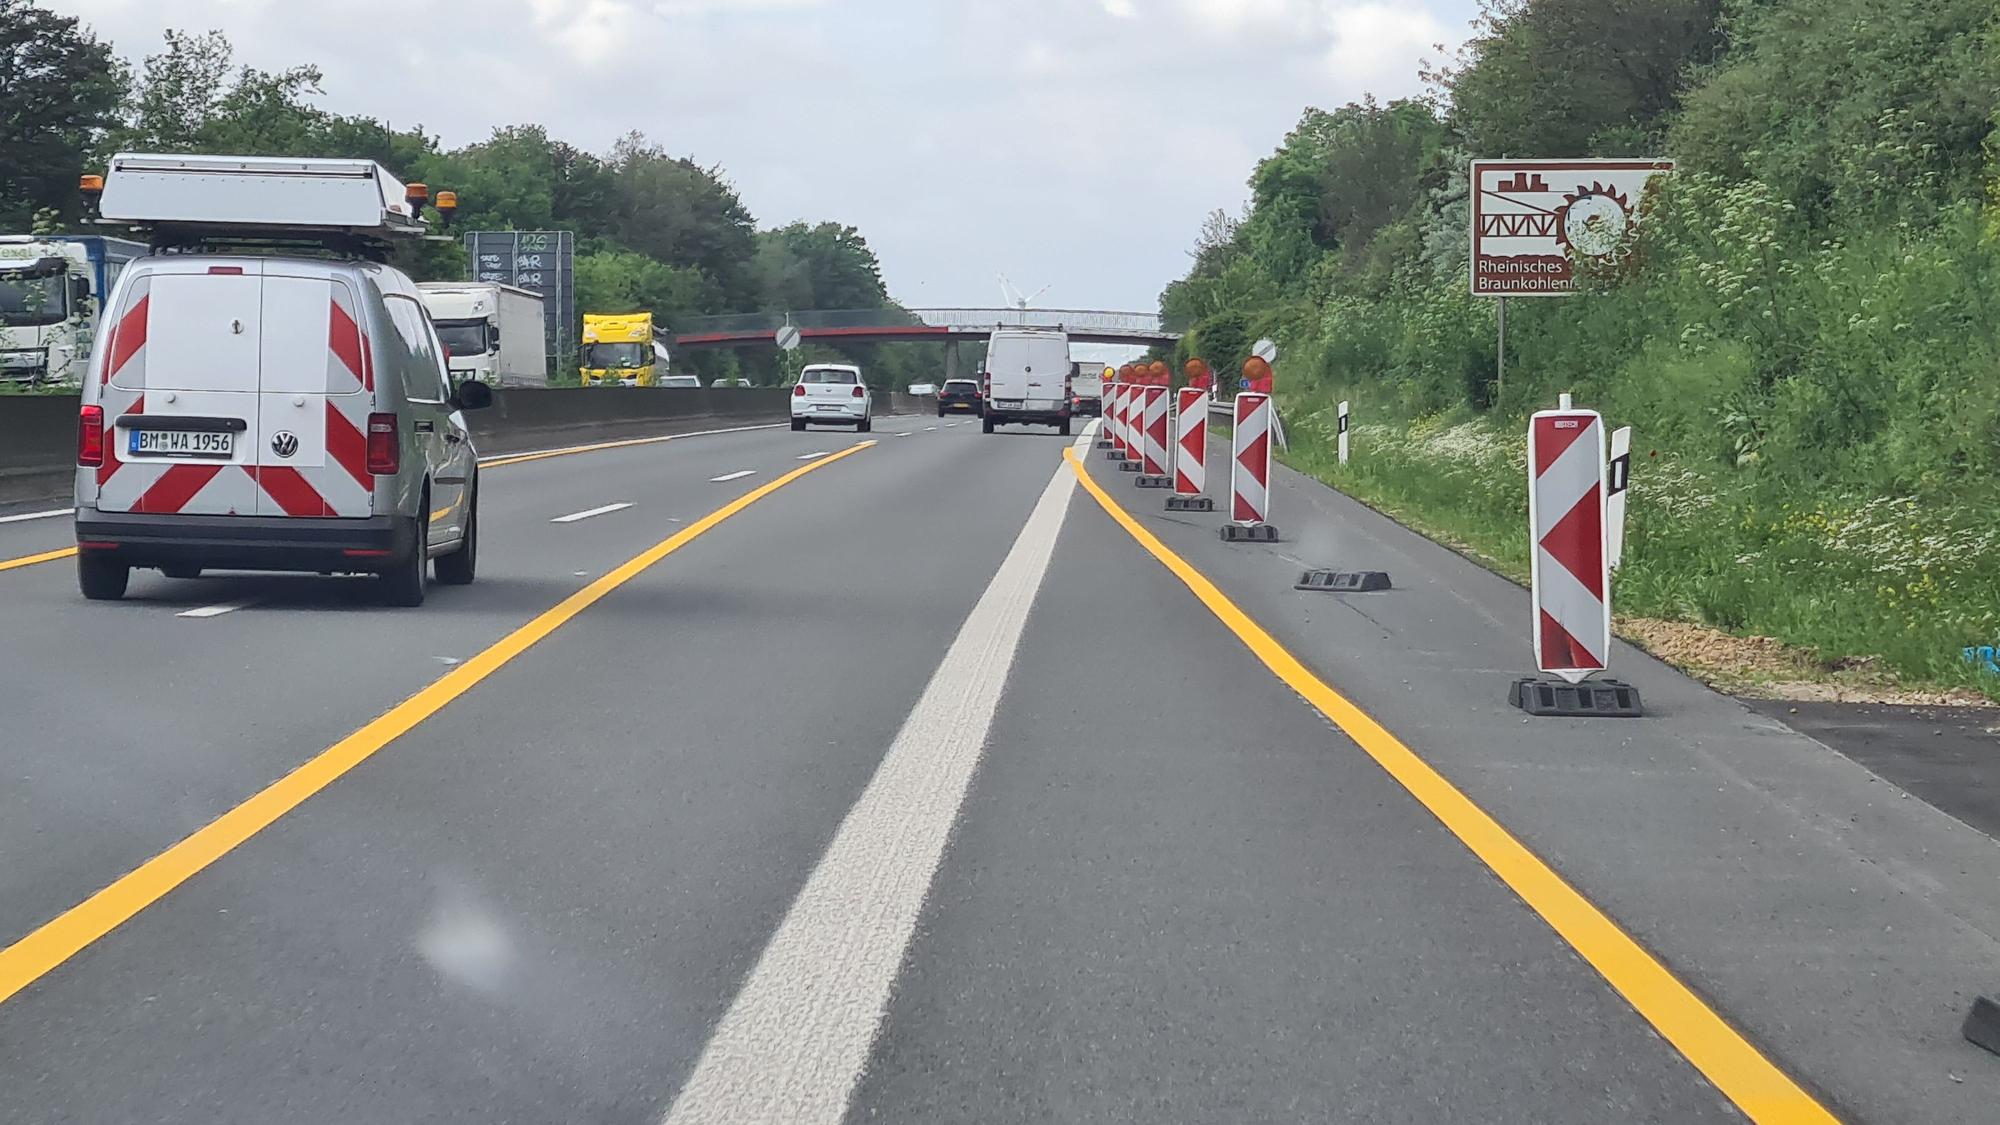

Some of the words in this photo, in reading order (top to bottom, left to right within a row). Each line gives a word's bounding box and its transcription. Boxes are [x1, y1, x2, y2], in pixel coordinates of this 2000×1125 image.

[1479, 260, 1562, 273] Rheinisches
[140, 432, 159, 449] BM
[170, 433, 188, 449] WA
[193, 434, 229, 451] 1956
